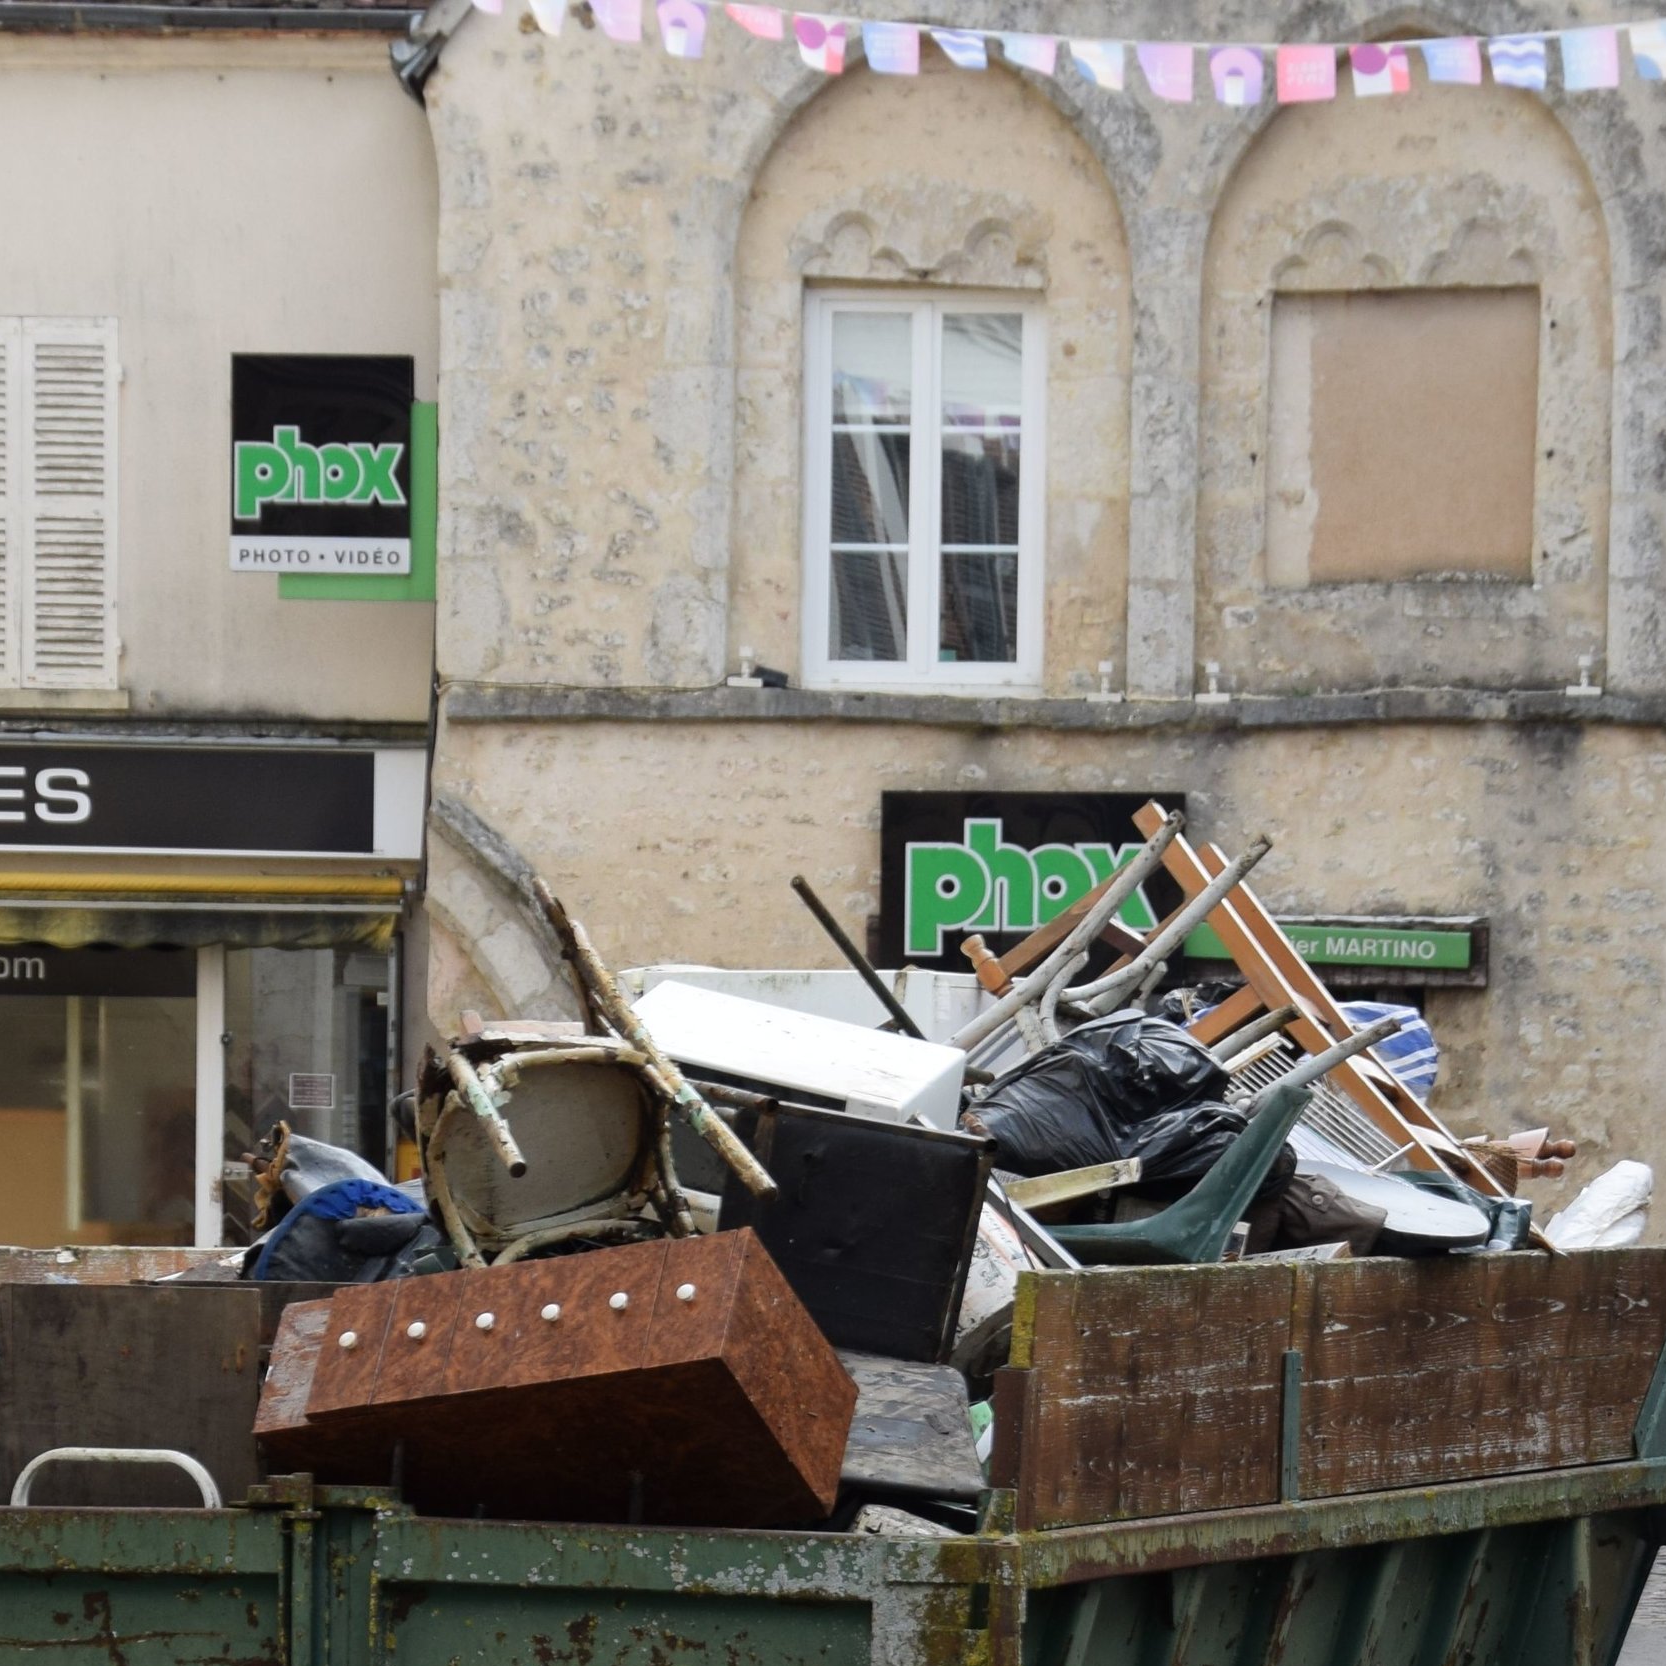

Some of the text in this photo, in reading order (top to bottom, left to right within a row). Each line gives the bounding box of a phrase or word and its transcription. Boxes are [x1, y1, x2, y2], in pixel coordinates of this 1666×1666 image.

[234, 425, 408, 520] phox
[239, 548, 401, 565] PHOTO VIDÉO
[1325, 936, 1436, 960] MARTINO
